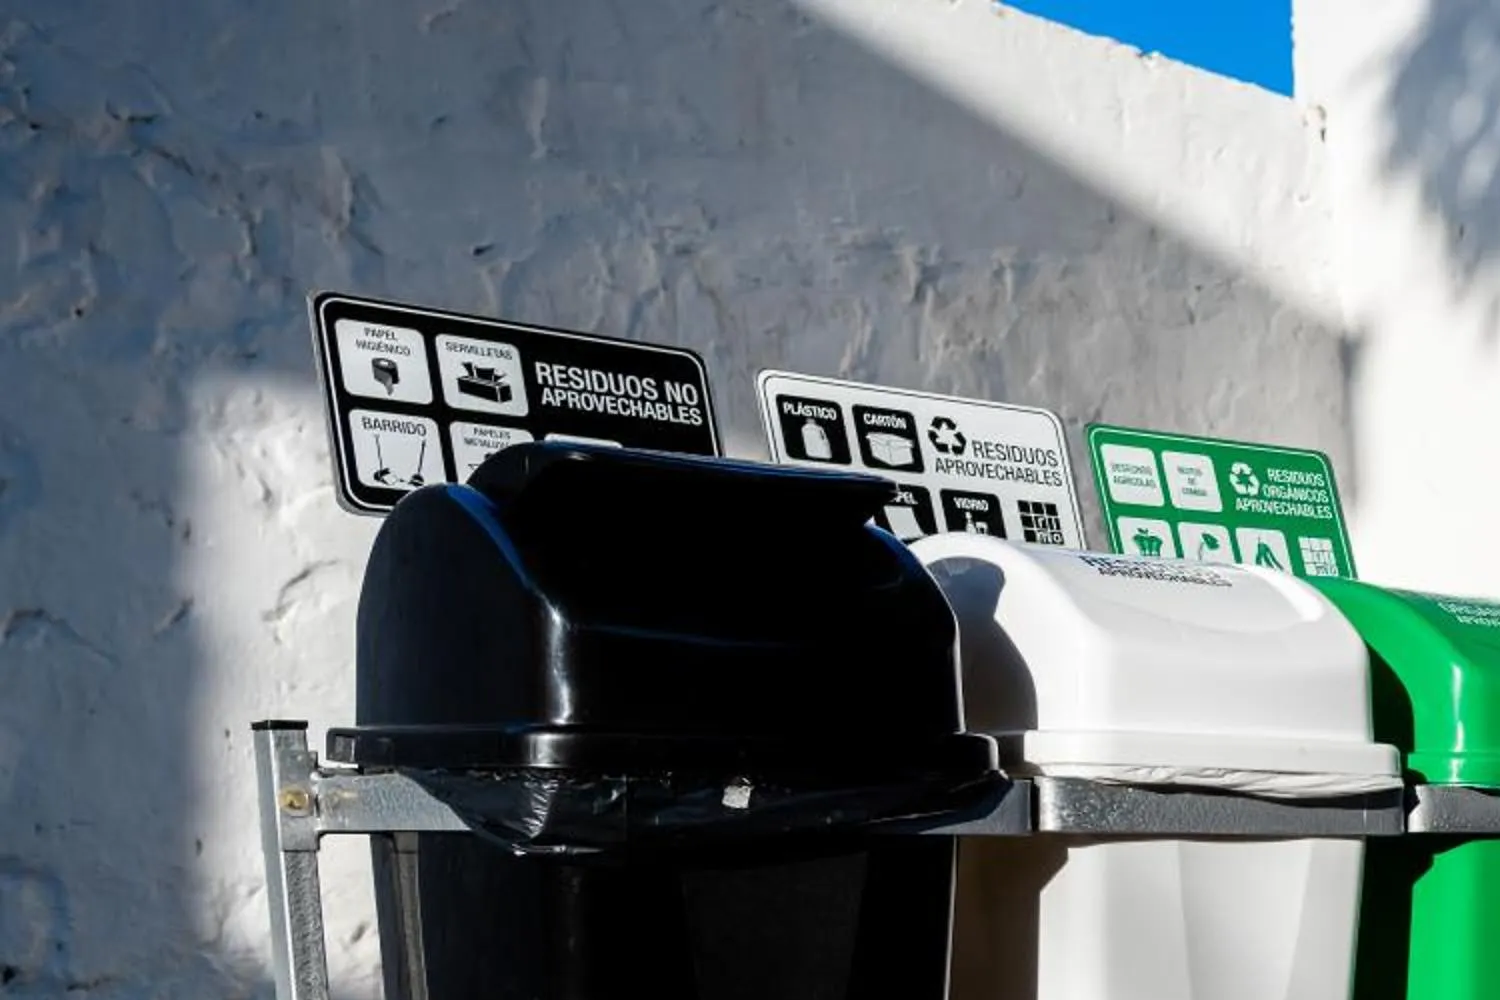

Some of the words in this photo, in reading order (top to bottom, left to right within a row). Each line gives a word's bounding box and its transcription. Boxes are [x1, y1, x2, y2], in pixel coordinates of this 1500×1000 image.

[364, 326, 398, 341] PAPEL
[445, 340, 513, 361] SERVILLETAS
[535, 361, 659, 401] RESIDUOS
[664, 381, 699, 407] NO
[541, 388, 702, 426] APROVECHABLES
[783, 401, 837, 421] PLÁSTICO
[362, 415, 427, 437] BARRIDO
[863, 412, 908, 430] CARTÓN
[971, 439, 1059, 468] RESIDUOS
[934, 457, 1063, 488] APROVECHABLES
[1267, 467, 1325, 487] RESIDUOS
[953, 495, 989, 512] VIDRIO
[1261, 483, 1330, 503] ORGÁNICOS
[1235, 497, 1333, 519] APROVECHABLES
